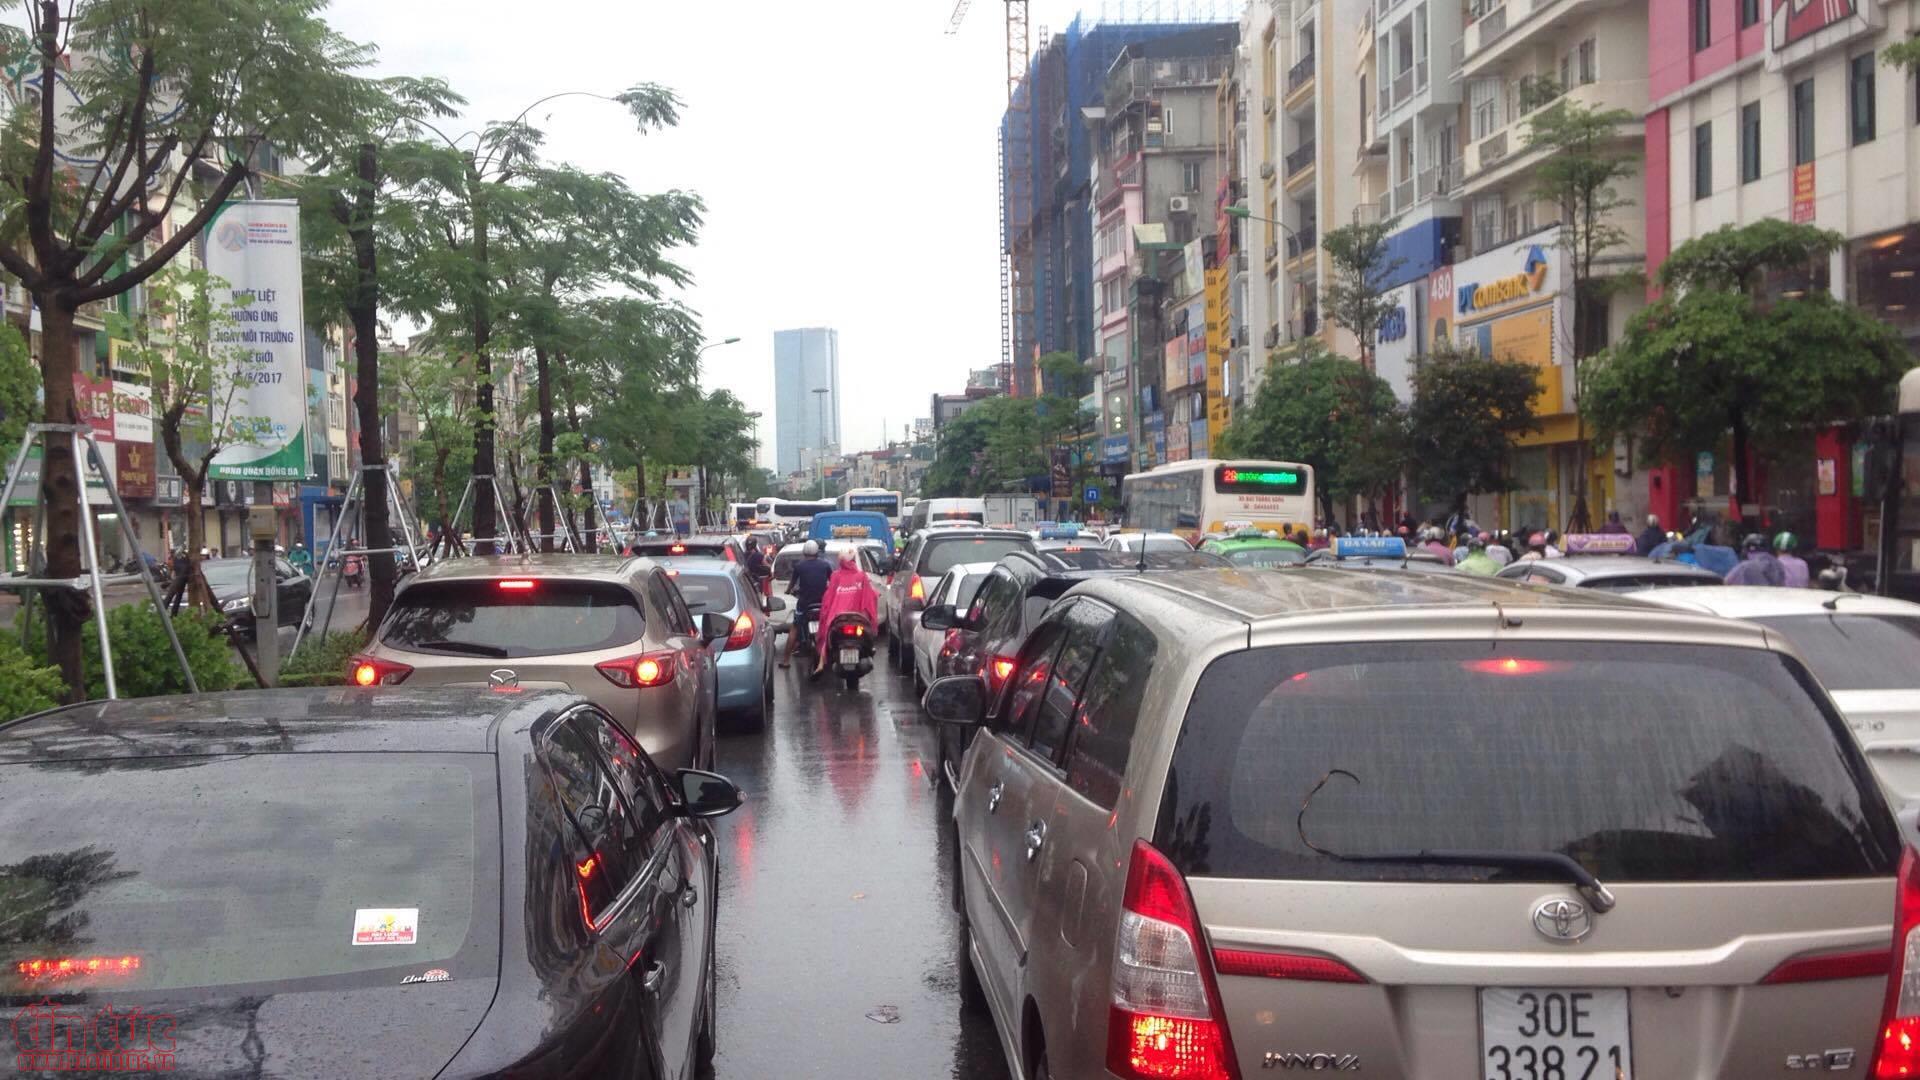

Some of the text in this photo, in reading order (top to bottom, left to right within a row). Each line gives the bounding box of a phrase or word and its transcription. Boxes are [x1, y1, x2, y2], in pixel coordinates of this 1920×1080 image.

[258, 288, 276, 303] LIỆT
[1431, 272, 1451, 302] 480
[242, 328, 257, 342] MÔI
[1517, 992, 1595, 1038] 30E
[1262, 1051, 1360, 1069] INNOVA
